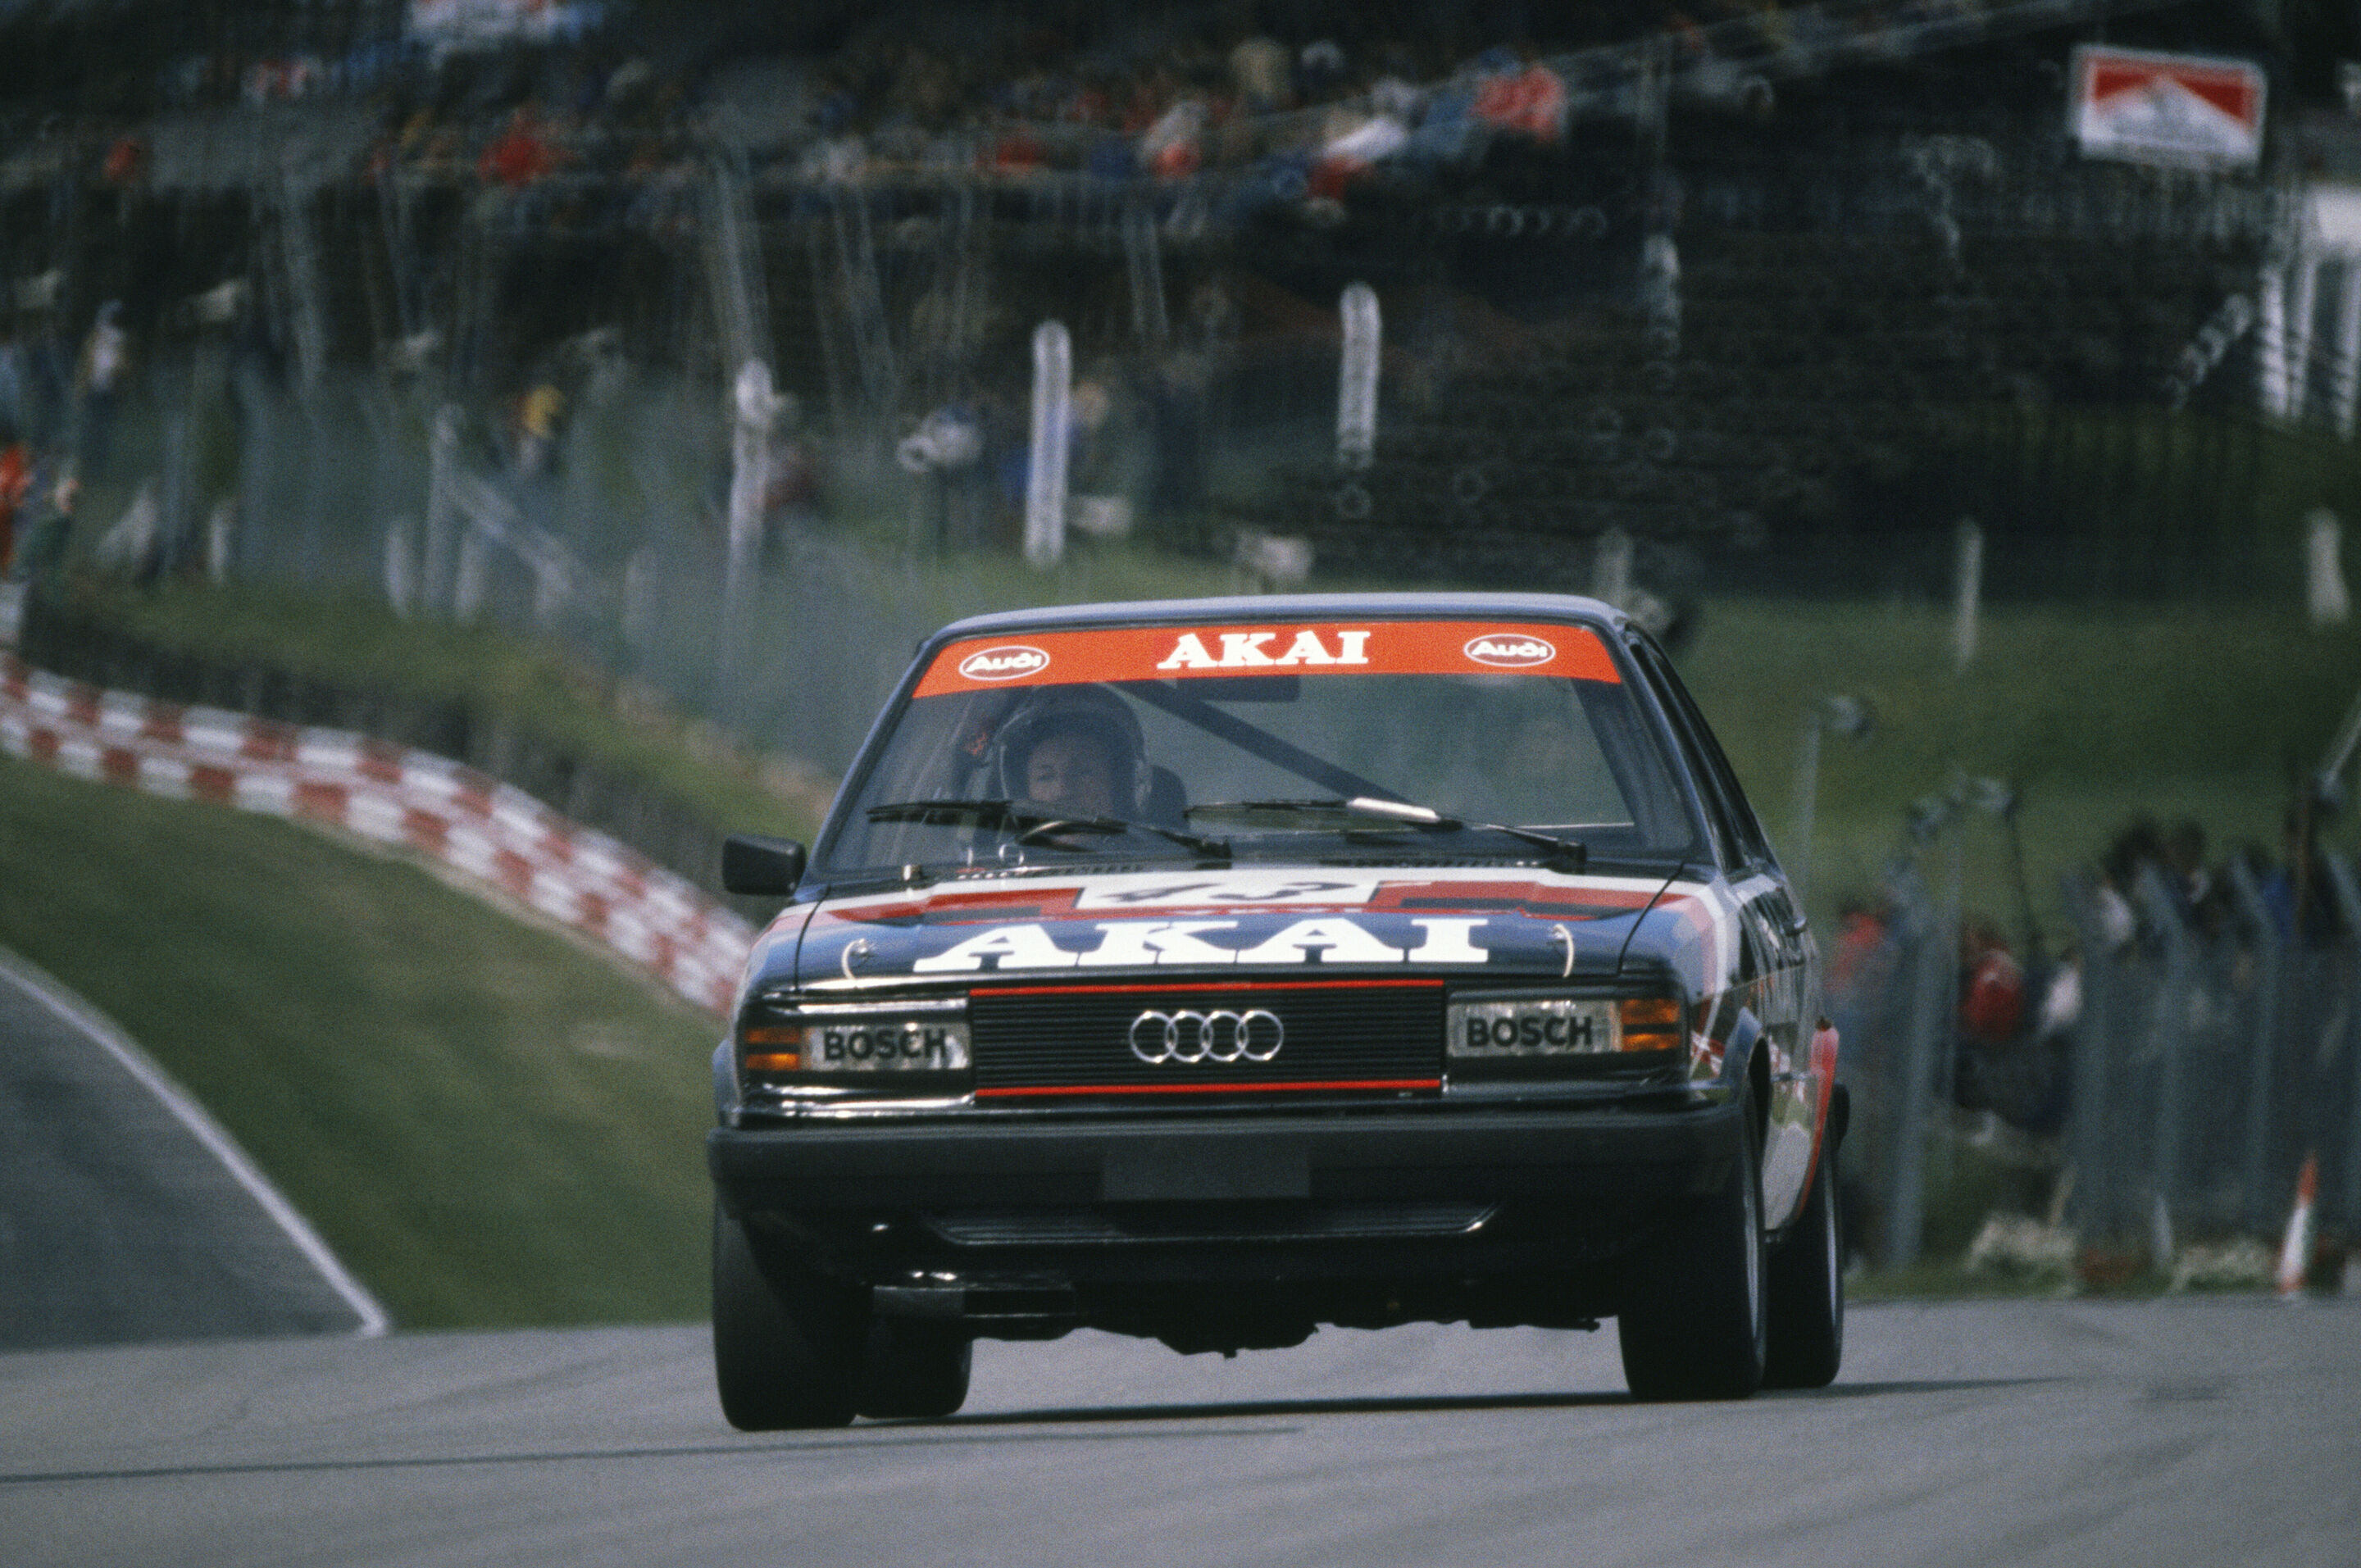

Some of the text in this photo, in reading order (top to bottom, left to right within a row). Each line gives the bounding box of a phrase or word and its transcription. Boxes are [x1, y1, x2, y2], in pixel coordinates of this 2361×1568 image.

[965, 652, 1042, 672] Audi
[1157, 630, 1371, 669] AKAI
[1471, 641, 1548, 657] Audi
[912, 917, 1489, 973] AKAI
[823, 1027, 947, 1061] BOSCH
[1466, 1016, 1593, 1048] BOSCH
